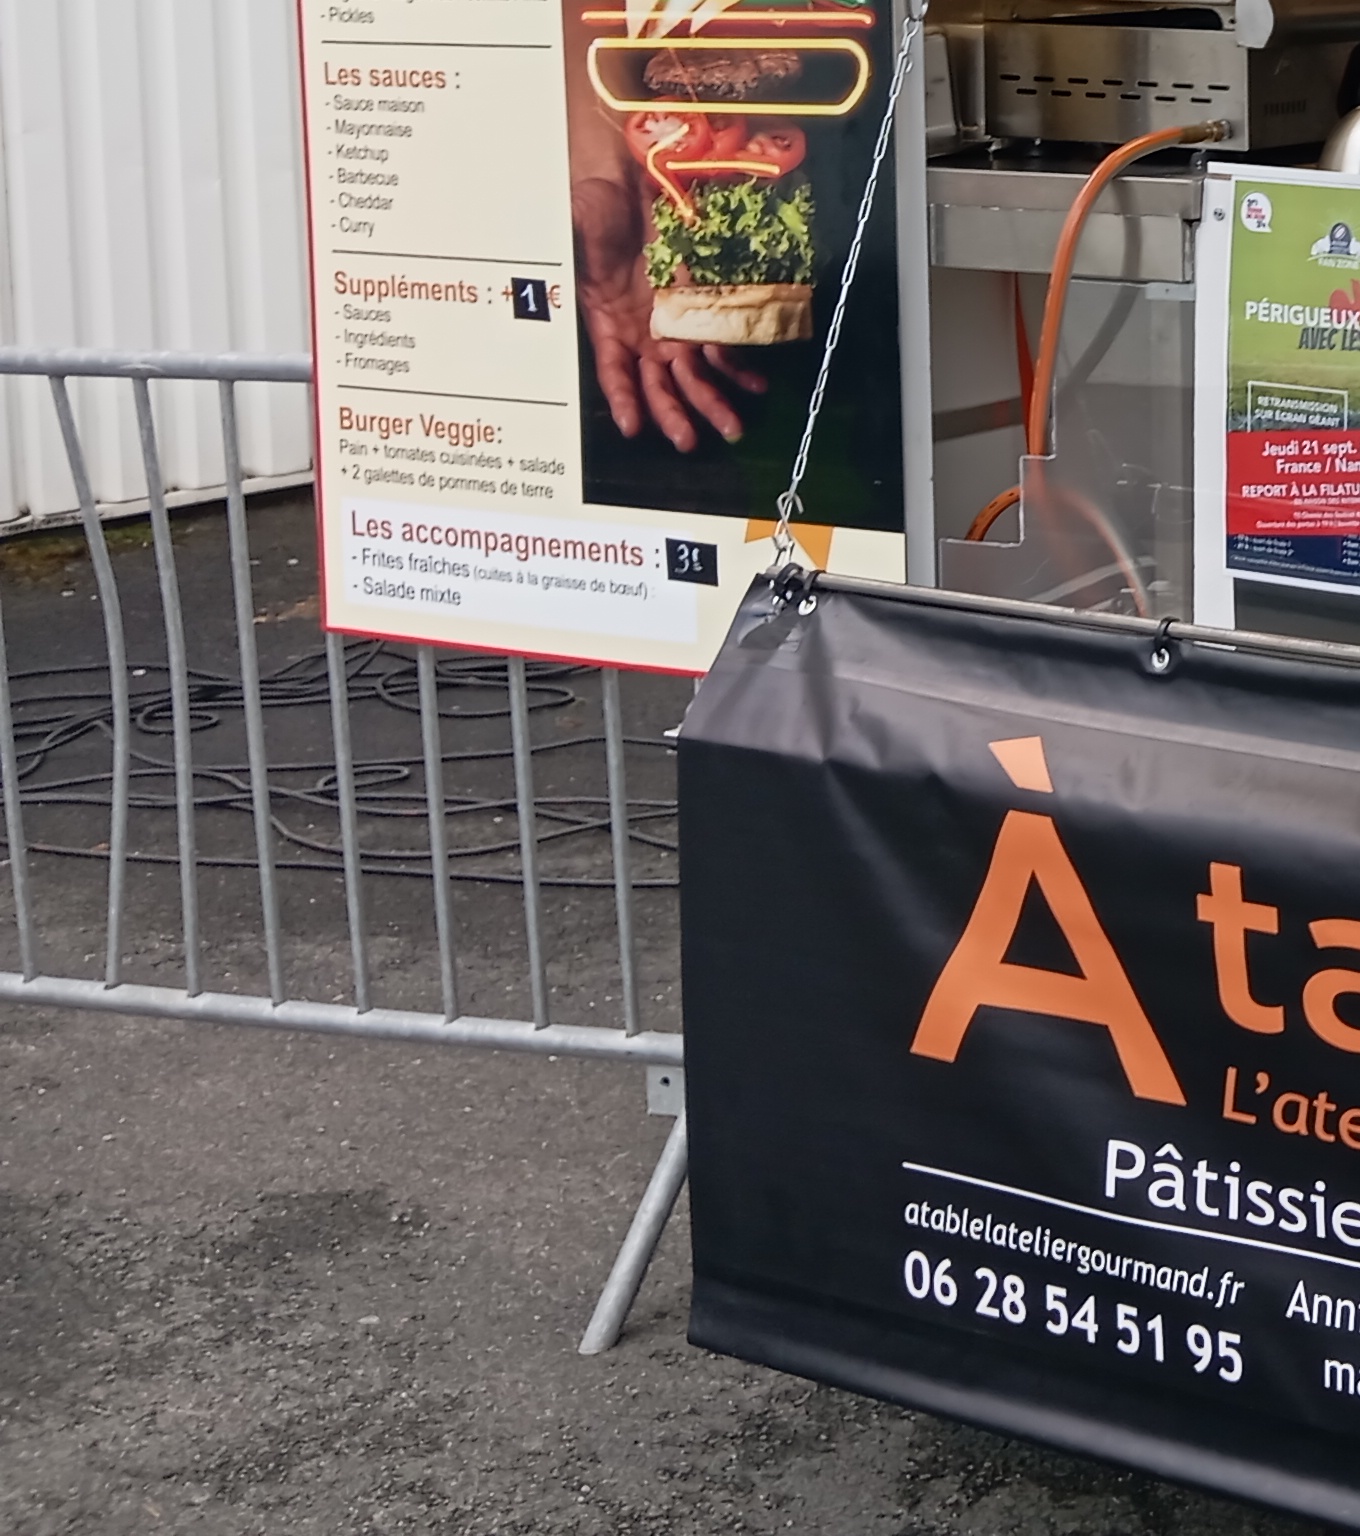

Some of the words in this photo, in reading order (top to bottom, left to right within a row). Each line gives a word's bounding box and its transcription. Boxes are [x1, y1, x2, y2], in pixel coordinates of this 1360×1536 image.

[325, 62, 361, 86] Les
[369, 68, 446, 89] sauces
[335, 119, 412, 139] Mayonnaise
[336, 144, 388, 163] Ketchup
[338, 168, 398, 186] Barbecue
[340, 217, 374, 237] Curry
[334, 271, 478, 303] Suppléments
[1299, 328, 1338, 350] AVEC
[339, 407, 412, 439] Burger
[1255, 409, 1272, 420] SUR
[1262, 440, 1299, 457] Jeudi
[1303, 441, 1318, 455] 21
[1323, 441, 1357, 458] sept.
[1277, 459, 1321, 474] France
[1242, 484, 1287, 498] REPORT
[1290, 482, 1299, 496] À
[1302, 484, 1318, 496] LA
[352, 510, 392, 539] Les
[402, 522, 643, 566] accompagnements
[363, 549, 404, 570] Frites
[409, 553, 469, 578] fraîches
[364, 577, 414, 601] Salade
[421, 585, 461, 606] mixte
[910, 735, 1187, 1107] À
[904, 1199, 1245, 1307] atablelateliergourmand.fr
[904, 1250, 958, 1306] 06
[975, 1268, 1027, 1325] 28
[1045, 1283, 1098, 1344] 54
[1116, 1303, 1166, 1362] 51
[1187, 1325, 1243, 1383] 95
